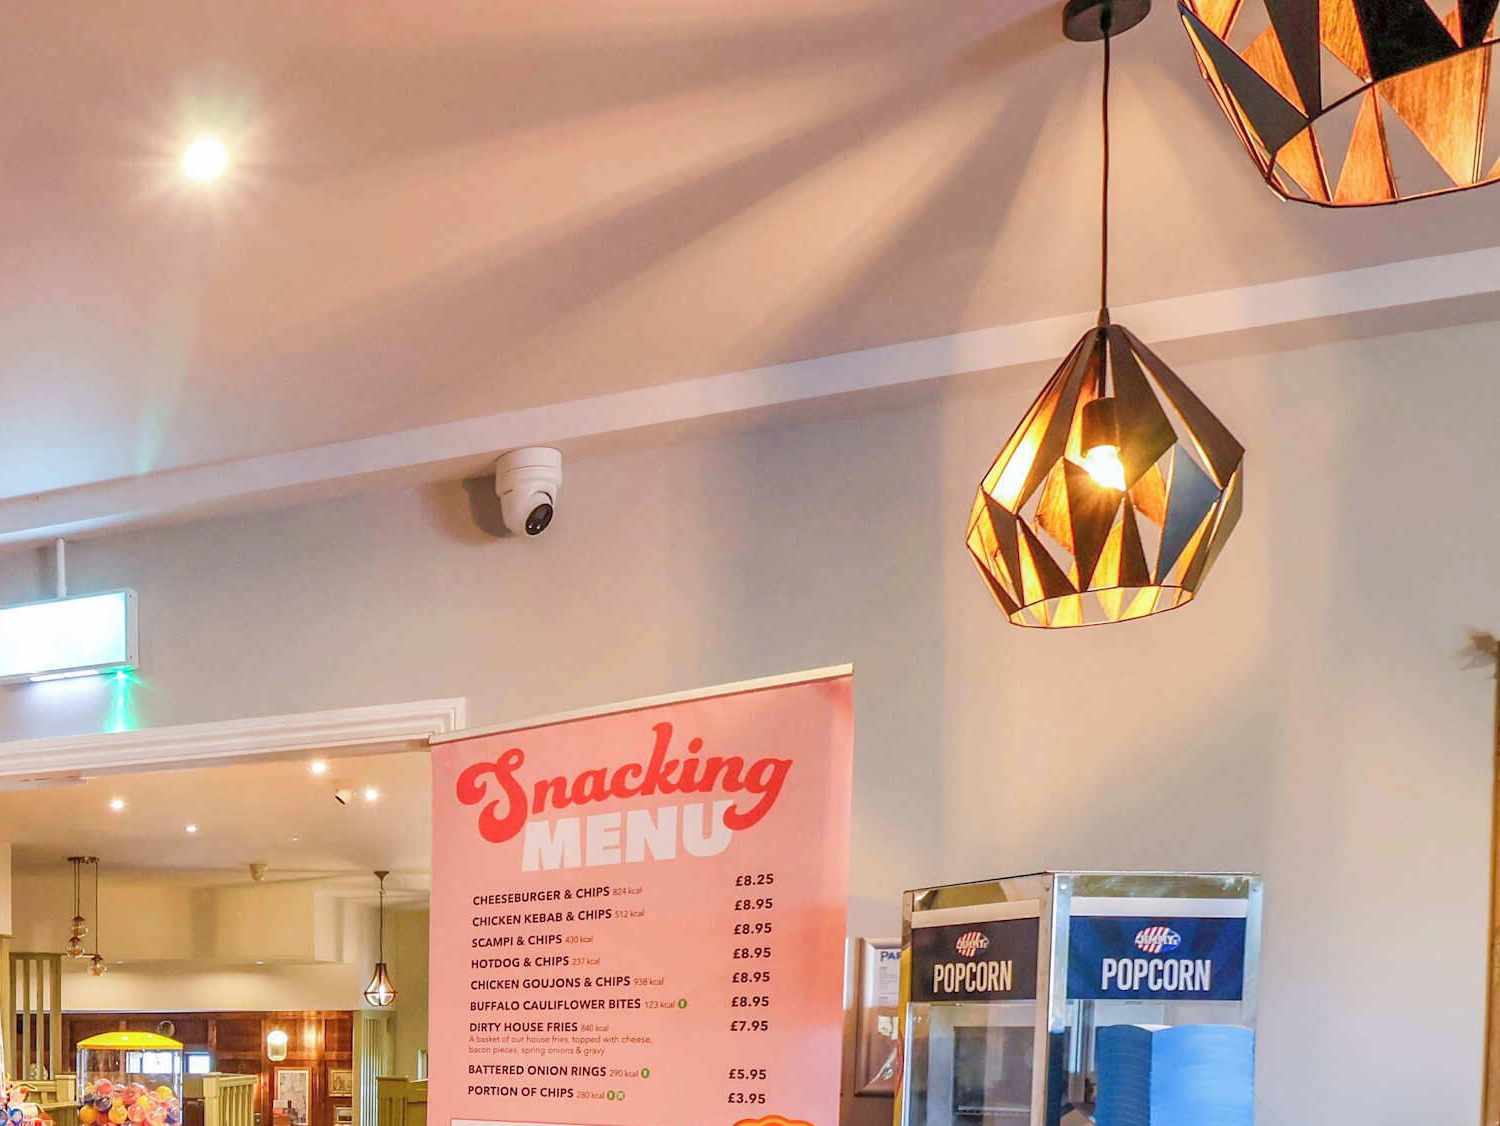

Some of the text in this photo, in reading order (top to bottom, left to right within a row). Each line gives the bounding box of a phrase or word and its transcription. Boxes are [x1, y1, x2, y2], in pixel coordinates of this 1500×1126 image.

[456, 722, 793, 843] Snacking
[522, 799, 735, 872] MENU
[735, 873, 774, 887] £8.25
[473, 886, 611, 906] CHEESEBURGER & CHIPS
[734, 898, 773, 911] £8.95
[472, 908, 612, 927] CHICKEN KEBAB & CHIPS
[733, 922, 772, 935] £8.95
[472, 934, 562, 948] SCAMPI & CHIPS
[732, 947, 771, 959] £8.95
[471, 956, 569, 969] HOTDOG & CHIPS
[731, 971, 770, 984] £8.95
[933, 960, 1012, 993] POPCORN
[1102, 958, 1212, 991] POPCORN
[471, 976, 630, 990] CHICKEN GOUJONS & CHIPS
[470, 998, 641, 1011] BUFFALO CAULIFLOWER BITES
[731, 996, 769, 1008] £8.95
[469, 1022, 578, 1032] DIRTY HOUSE FRIES
[730, 1021, 768, 1032] £7.95
[468, 1065, 606, 1077] BATTERED ONION RINGS
[728, 1069, 767, 1080] £5.95
[468, 1086, 574, 1098] PORTION OF CHIPS
[727, 1093, 766, 1104] £3.95
